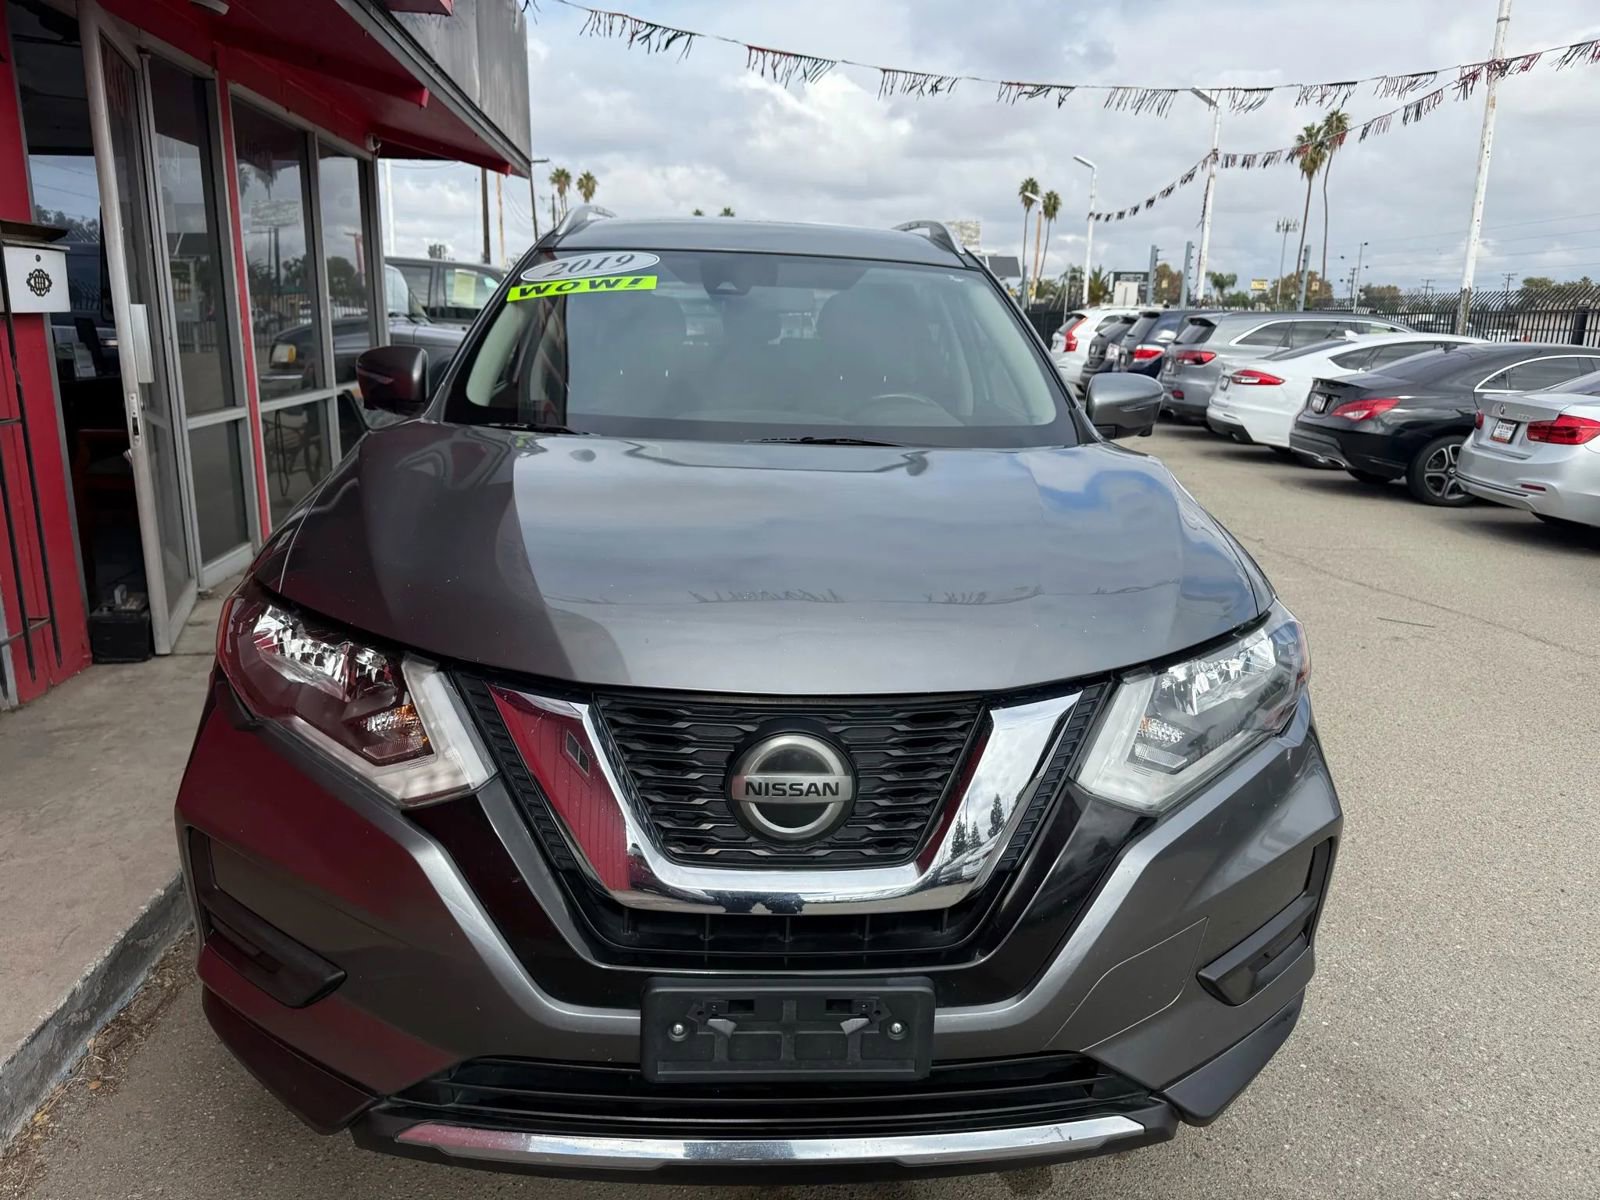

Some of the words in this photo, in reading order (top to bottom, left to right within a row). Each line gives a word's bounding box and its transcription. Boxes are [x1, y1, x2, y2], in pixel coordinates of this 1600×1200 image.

[545, 254, 635, 278] 2019
[519, 278, 643, 298] WOW!
[745, 782, 839, 797] NISSAN
